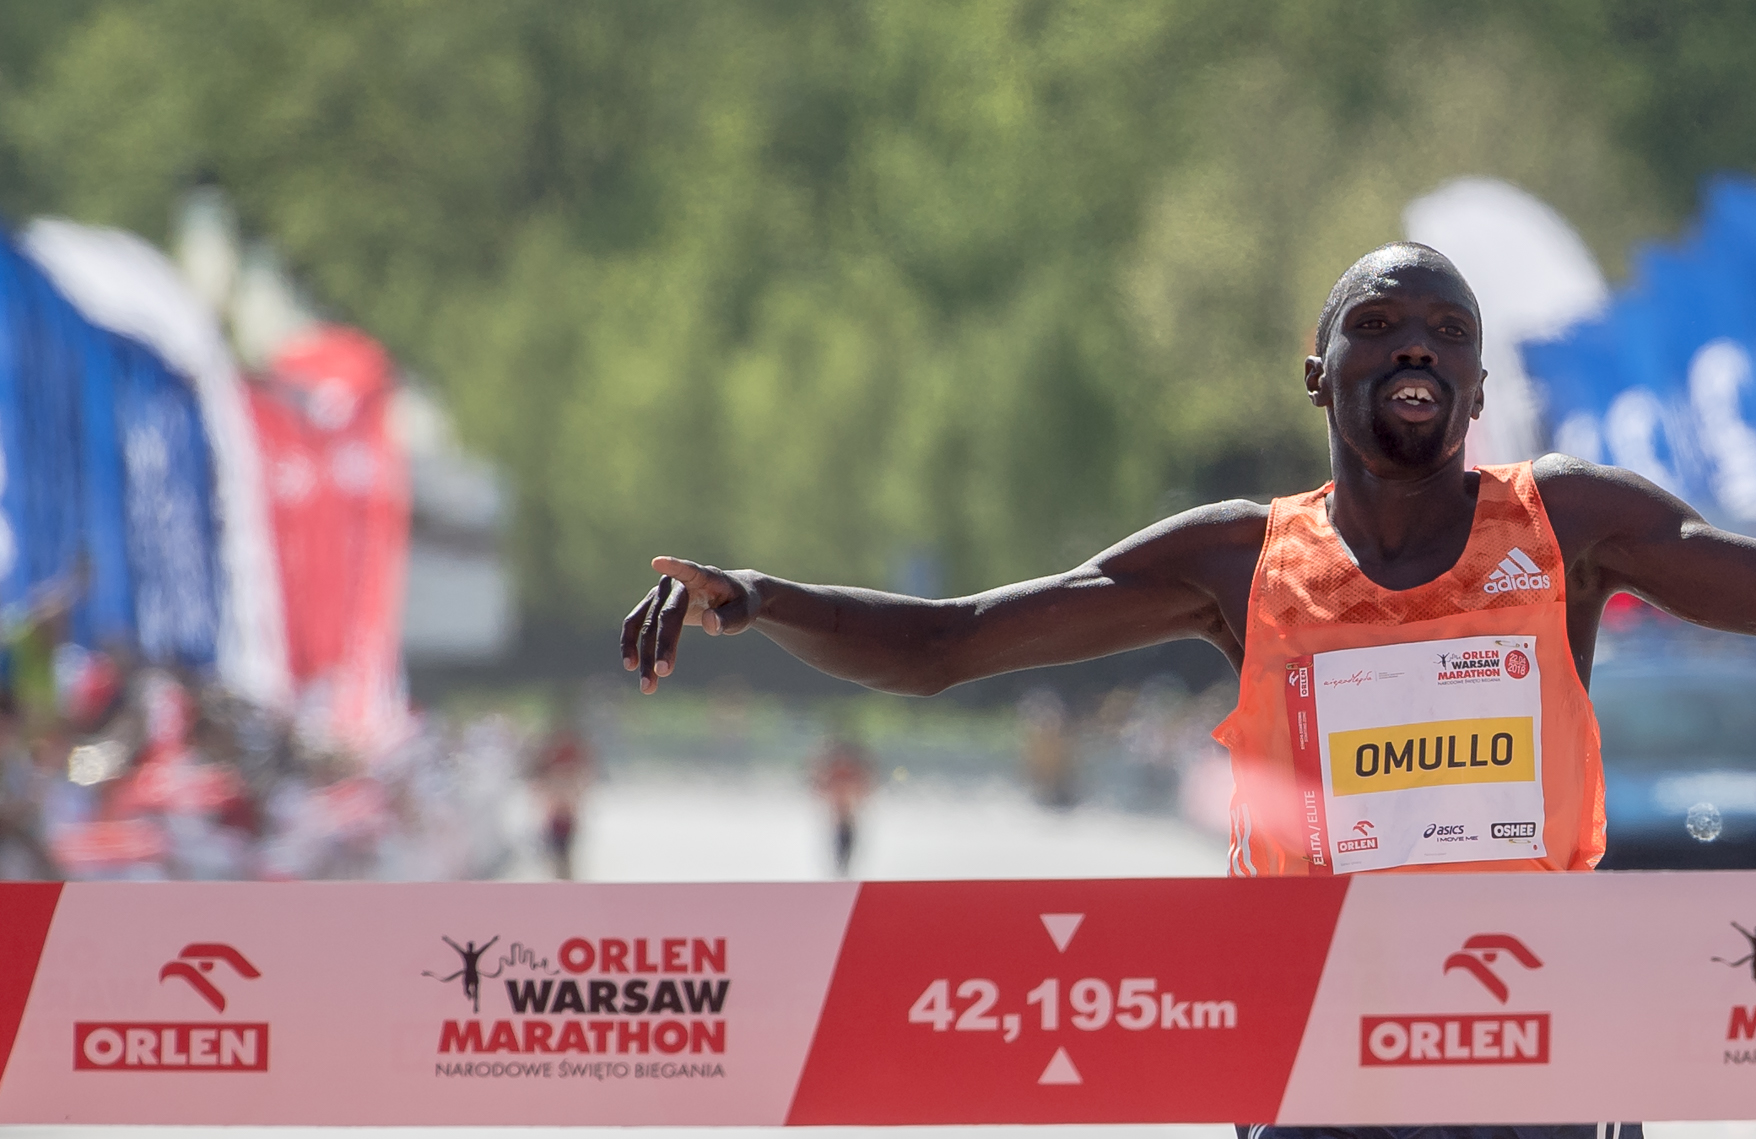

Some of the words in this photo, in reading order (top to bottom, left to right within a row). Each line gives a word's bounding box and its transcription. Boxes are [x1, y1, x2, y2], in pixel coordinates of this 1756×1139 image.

[1484, 573, 1550, 593] adidas
[1451, 659, 1500, 669] WARSAW
[1462, 650, 1499, 660] ORLEN
[1508, 664, 1525, 675] 2018
[1437, 668, 1500, 680] MARATHON
[1355, 732, 1513, 777] OMULLO
[1304, 791, 1318, 823] ELITE
[1340, 839, 1376, 851] ORLEN
[1493, 824, 1534, 837] OSHEE
[1310, 832, 1324, 865] ELITA
[558, 937, 727, 974] ORLEN
[505, 979, 730, 1014] WARSAW
[908, 979, 1237, 1042] 42,195km
[83, 1027, 258, 1067] ORLEN
[437, 1019, 726, 1055] MARATHON
[1369, 1020, 1540, 1060] ORLEN
[435, 1062, 551, 1078] NARODOWE
[558, 1059, 628, 1081] ŚWIĘTO
[635, 1062, 724, 1078] BIEGANIA
